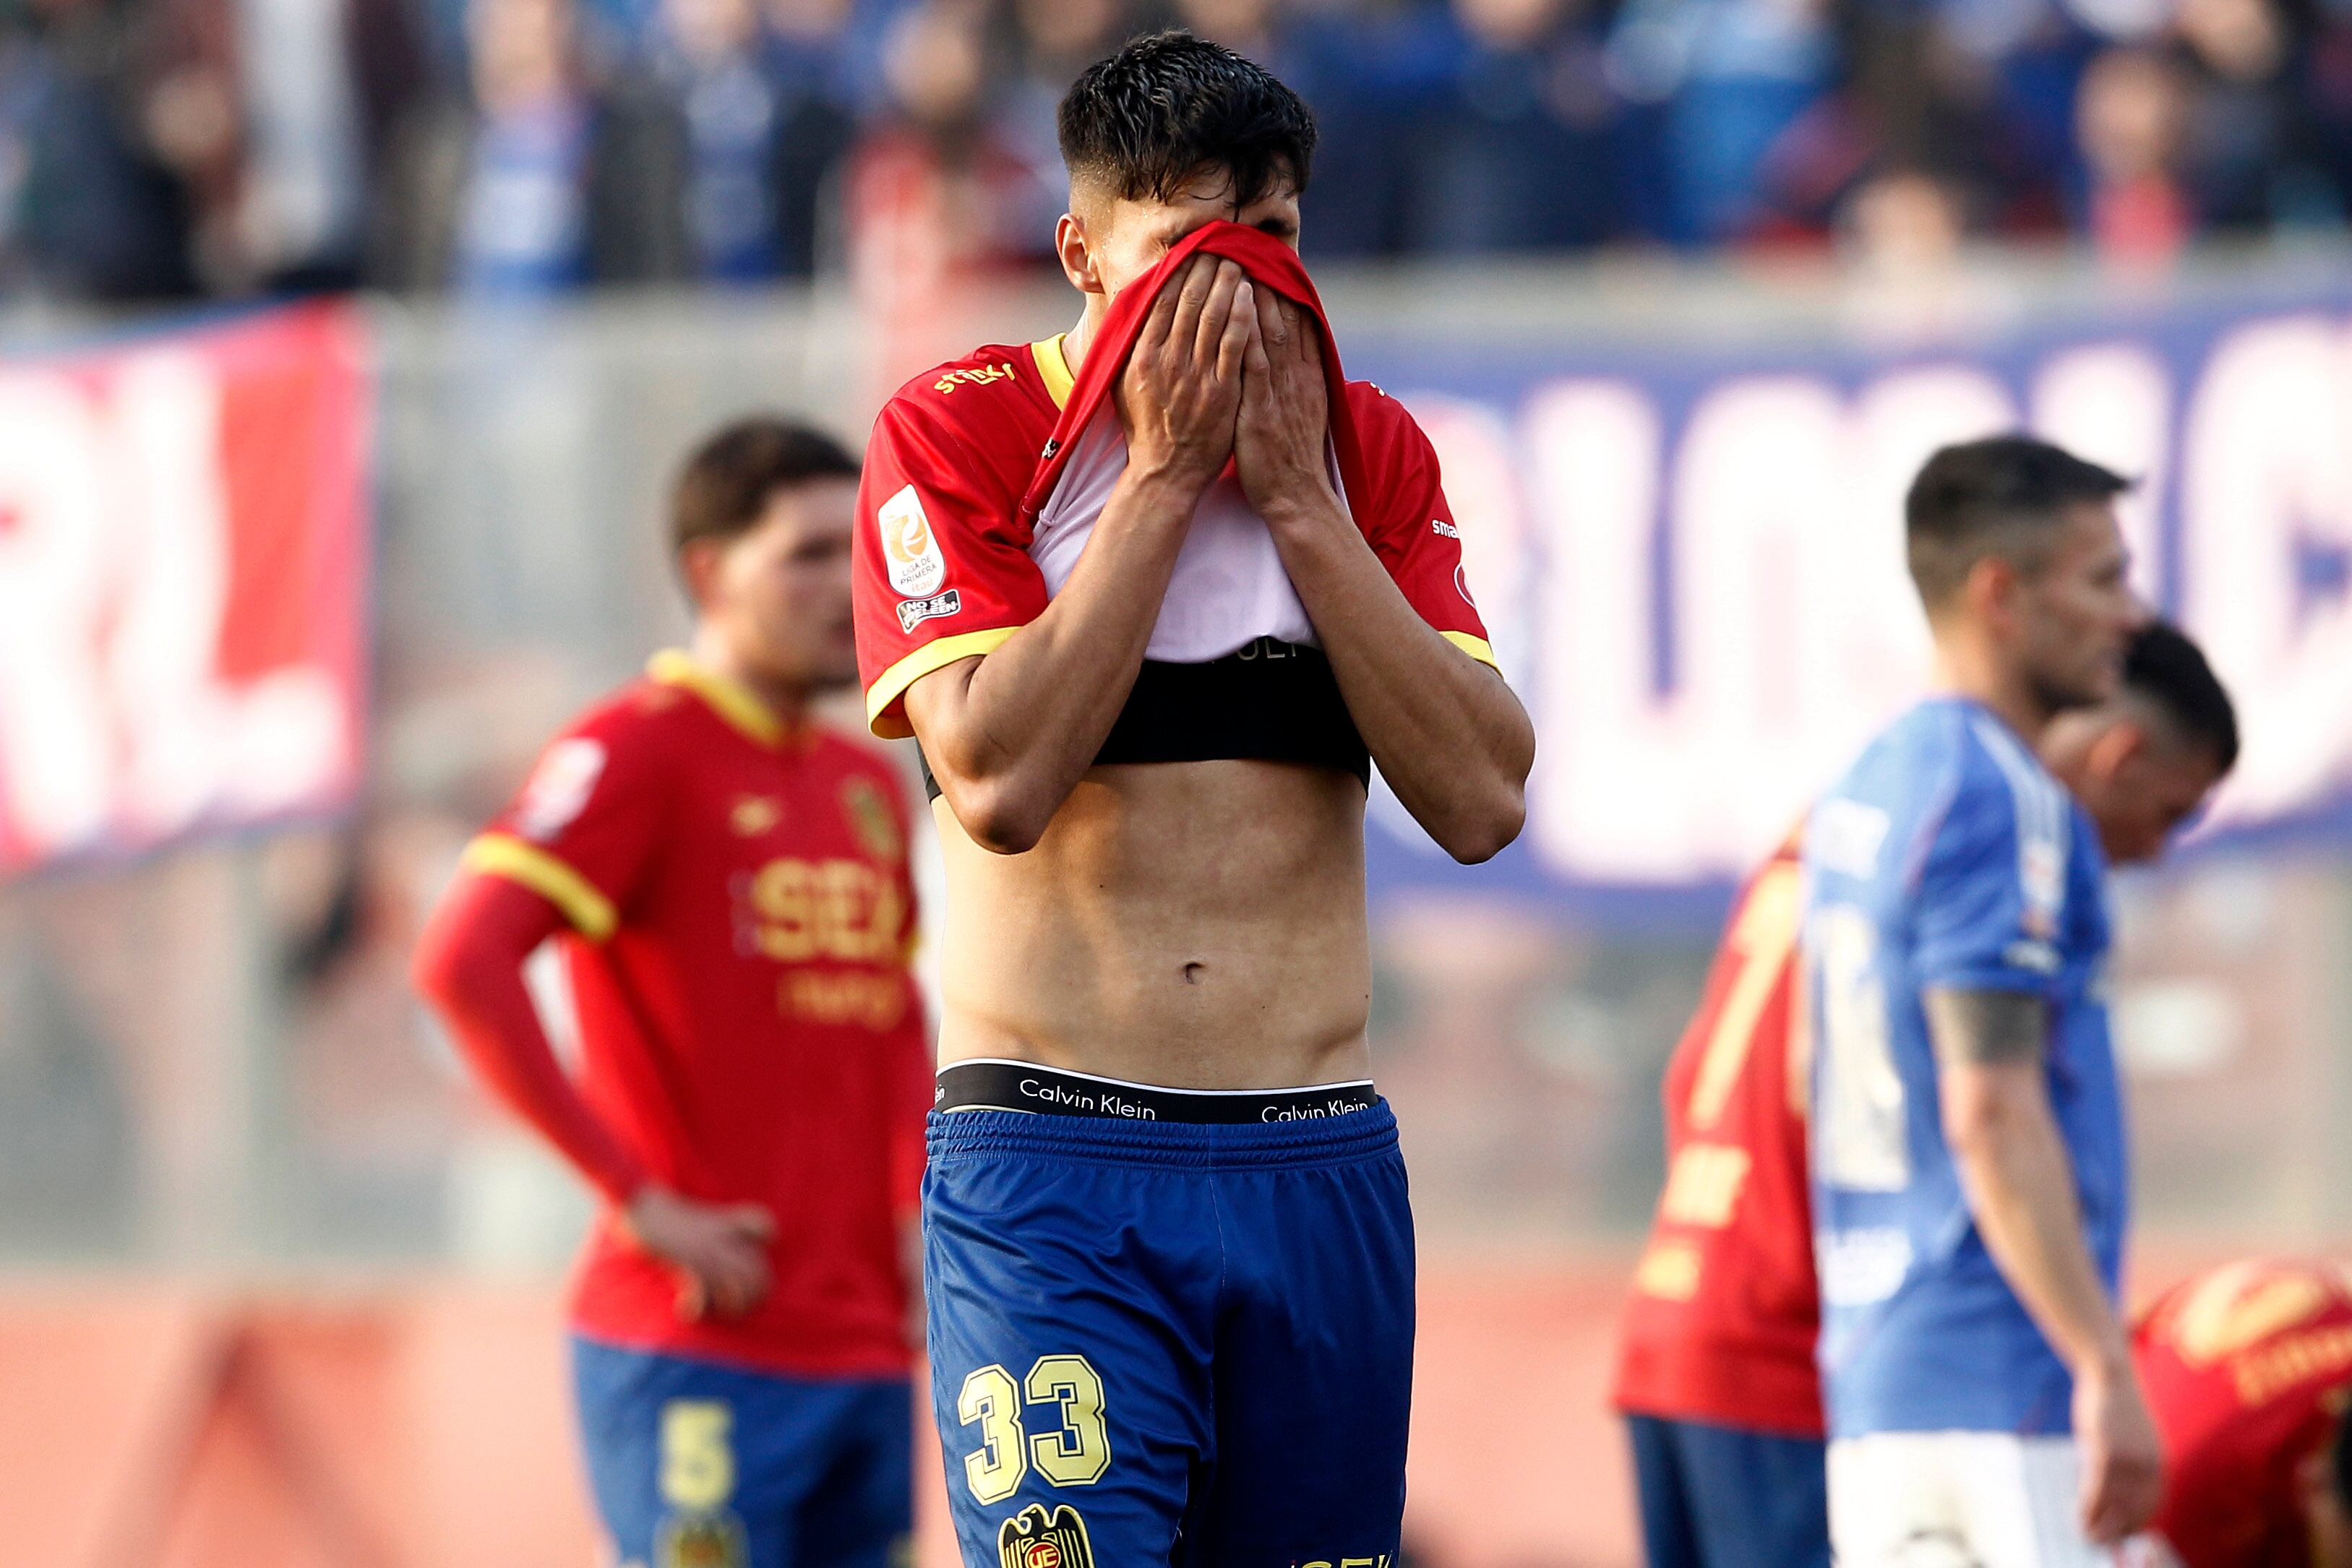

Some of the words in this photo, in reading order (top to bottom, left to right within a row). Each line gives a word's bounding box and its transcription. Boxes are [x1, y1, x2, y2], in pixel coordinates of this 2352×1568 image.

[900, 563, 937, 585] PRIMERA
[901, 562, 921, 577] LIGA
[920, 554, 932, 567] DE
[906, 600, 927, 613] NO
[930, 595, 946, 607] SE
[1020, 1079, 1094, 1110] Calvin
[1101, 1094, 1156, 1121] Klein
[1261, 1103, 1326, 1123] Calvin
[957, 1353, 1112, 1507] 33
